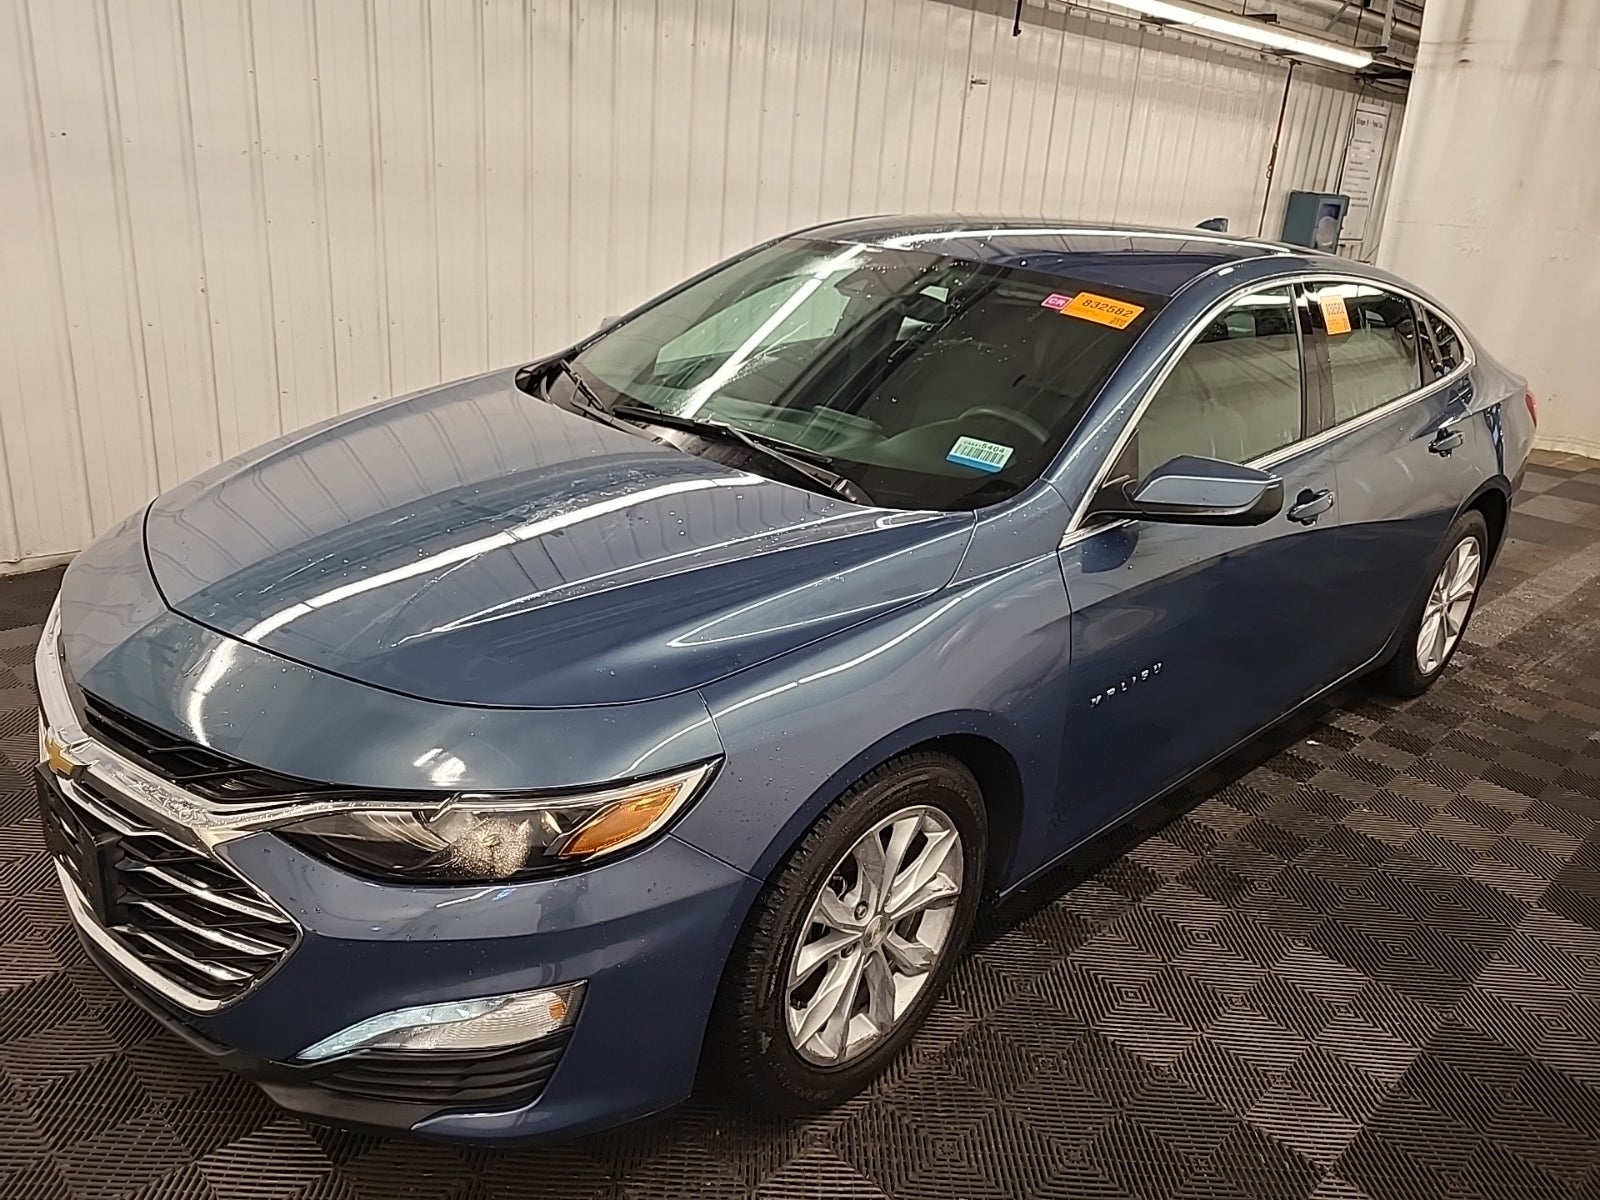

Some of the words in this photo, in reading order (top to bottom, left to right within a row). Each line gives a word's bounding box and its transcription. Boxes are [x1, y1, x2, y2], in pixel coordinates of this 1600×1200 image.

[1047, 297, 1066, 306] CR
[1082, 299, 1134, 318] 832582
[981, 443, 1005, 453] 5404
